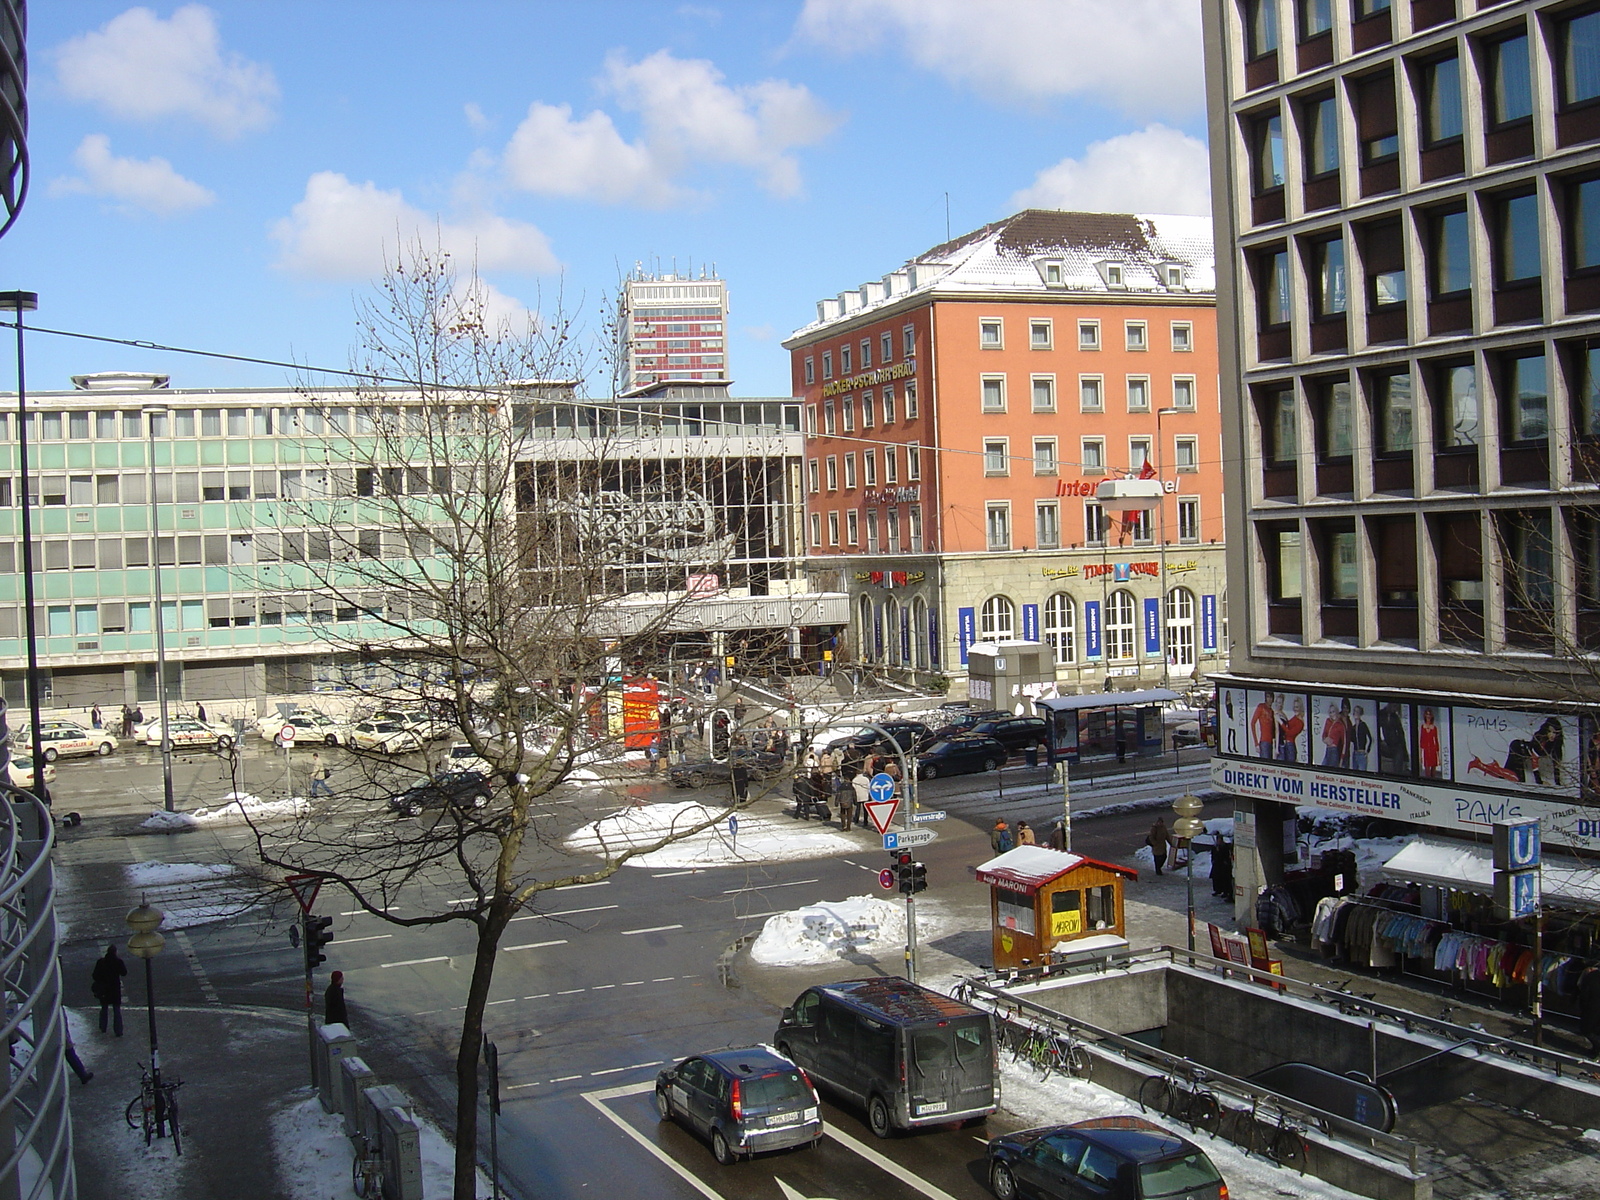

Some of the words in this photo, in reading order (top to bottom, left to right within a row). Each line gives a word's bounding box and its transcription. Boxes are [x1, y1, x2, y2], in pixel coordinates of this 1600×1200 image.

[1083, 564, 1114, 580] TIMES
[1129, 561, 1159, 577] SQUARE
[996, 659, 1004, 669] U
[1467, 714, 1507, 732] PAM'S
[1224, 769, 1269, 790] DIREKT
[1273, 776, 1304, 796] VOM
[1310, 781, 1401, 810] HERSTELLER
[1400, 785, 1432, 806] FRANKREICH
[912, 812, 945, 822] Bayerstraße
[1551, 807, 1577, 819] ITALIEN
[1578, 818, 1600, 839] DI
[887, 835, 895, 847] P
[898, 833, 931, 844] Parkgarage
[1513, 827, 1534, 864] U
[997, 878, 1028, 893] MARONI
